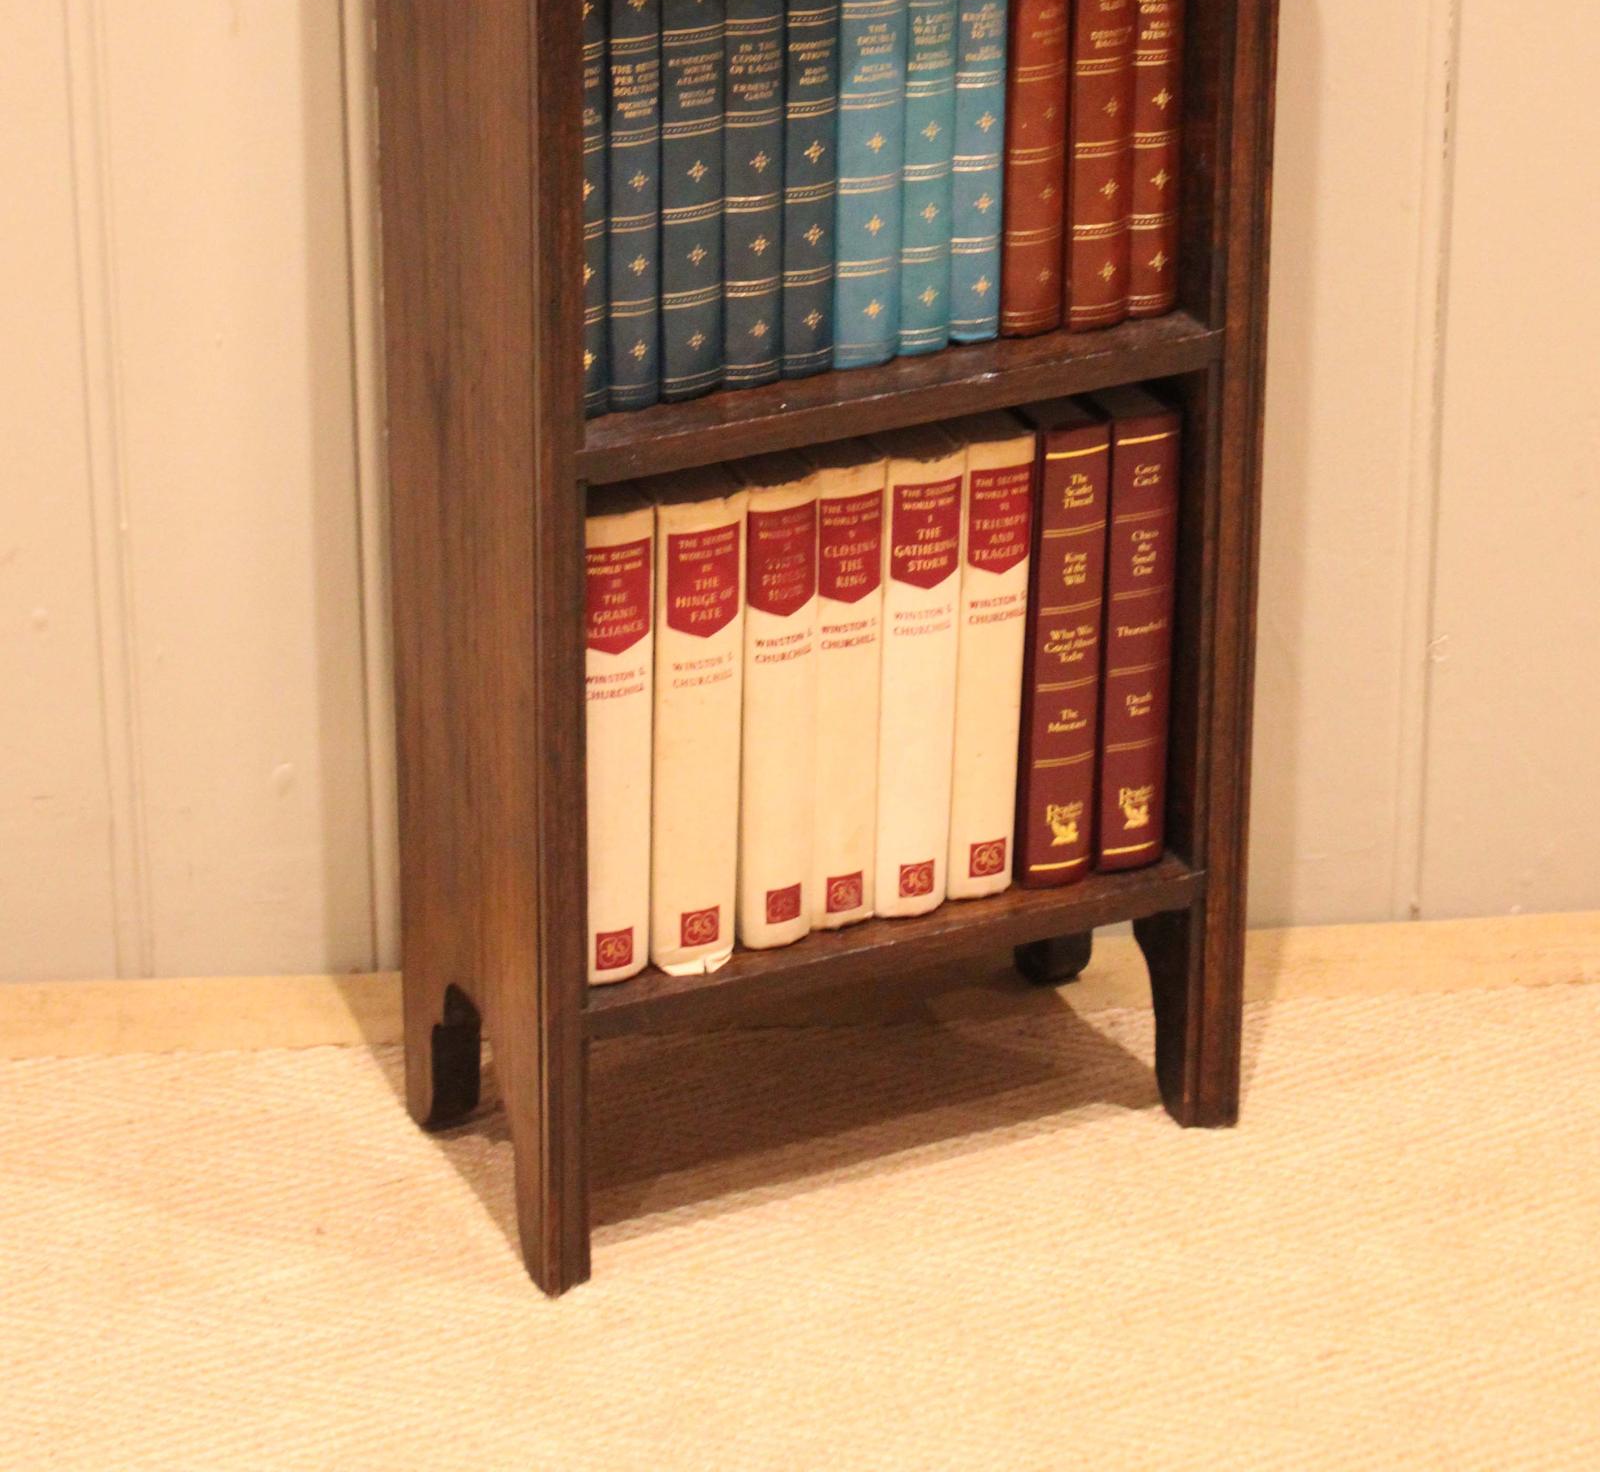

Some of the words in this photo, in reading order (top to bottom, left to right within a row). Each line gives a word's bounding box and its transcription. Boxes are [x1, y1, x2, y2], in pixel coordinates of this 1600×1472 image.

[1071, 473, 1089, 485] The
[916, 526, 943, 542] THE
[989, 530, 1015, 546] AND
[824, 538, 878, 559] CLOSING
[894, 535, 958, 559] GATHERING
[974, 543, 1025, 563] TRAGEDY
[840, 557, 864, 574] THE
[907, 554, 948, 573] STORM
[694, 576, 720, 592] THE
[836, 573, 868, 589] RING
[603, 593, 628, 606] THE
[676, 593, 717, 609] HINGE
[720, 586, 735, 602] OF
[593, 606, 637, 625] GRAND
[690, 607, 722, 624] FATE
[1061, 708, 1079, 721] The
